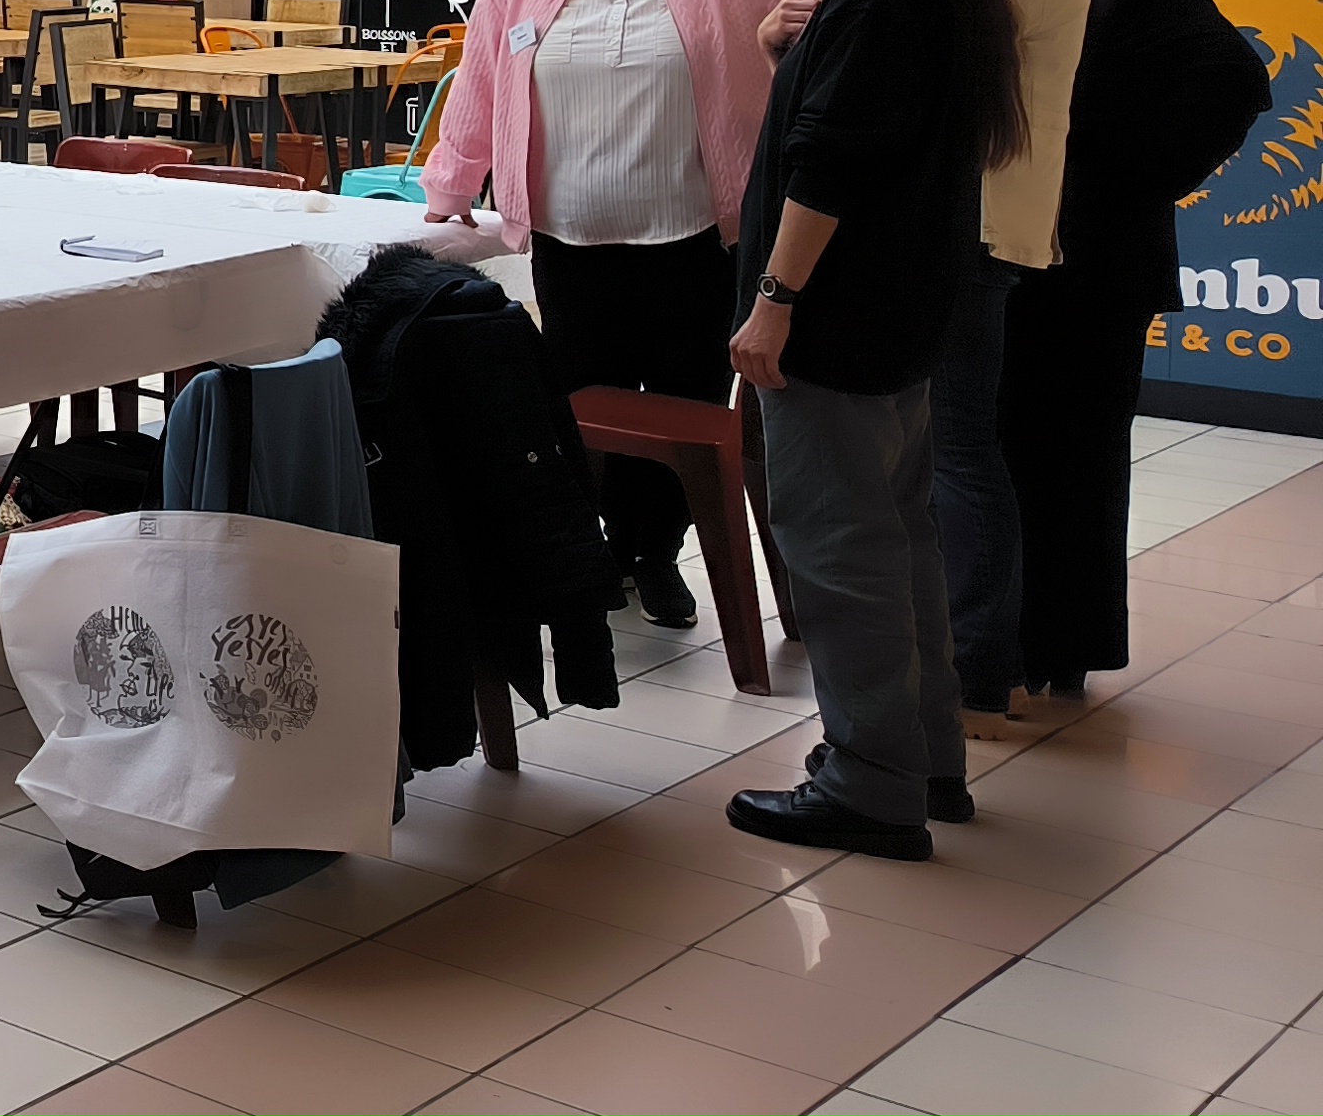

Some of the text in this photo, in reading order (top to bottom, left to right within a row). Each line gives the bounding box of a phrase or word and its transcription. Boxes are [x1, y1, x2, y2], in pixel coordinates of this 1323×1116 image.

[361, 28, 416, 41] BOISSONS
[379, 41, 397, 52] ET
[1182, 324, 1211, 352] &
[1226, 329, 1291, 360] CO
